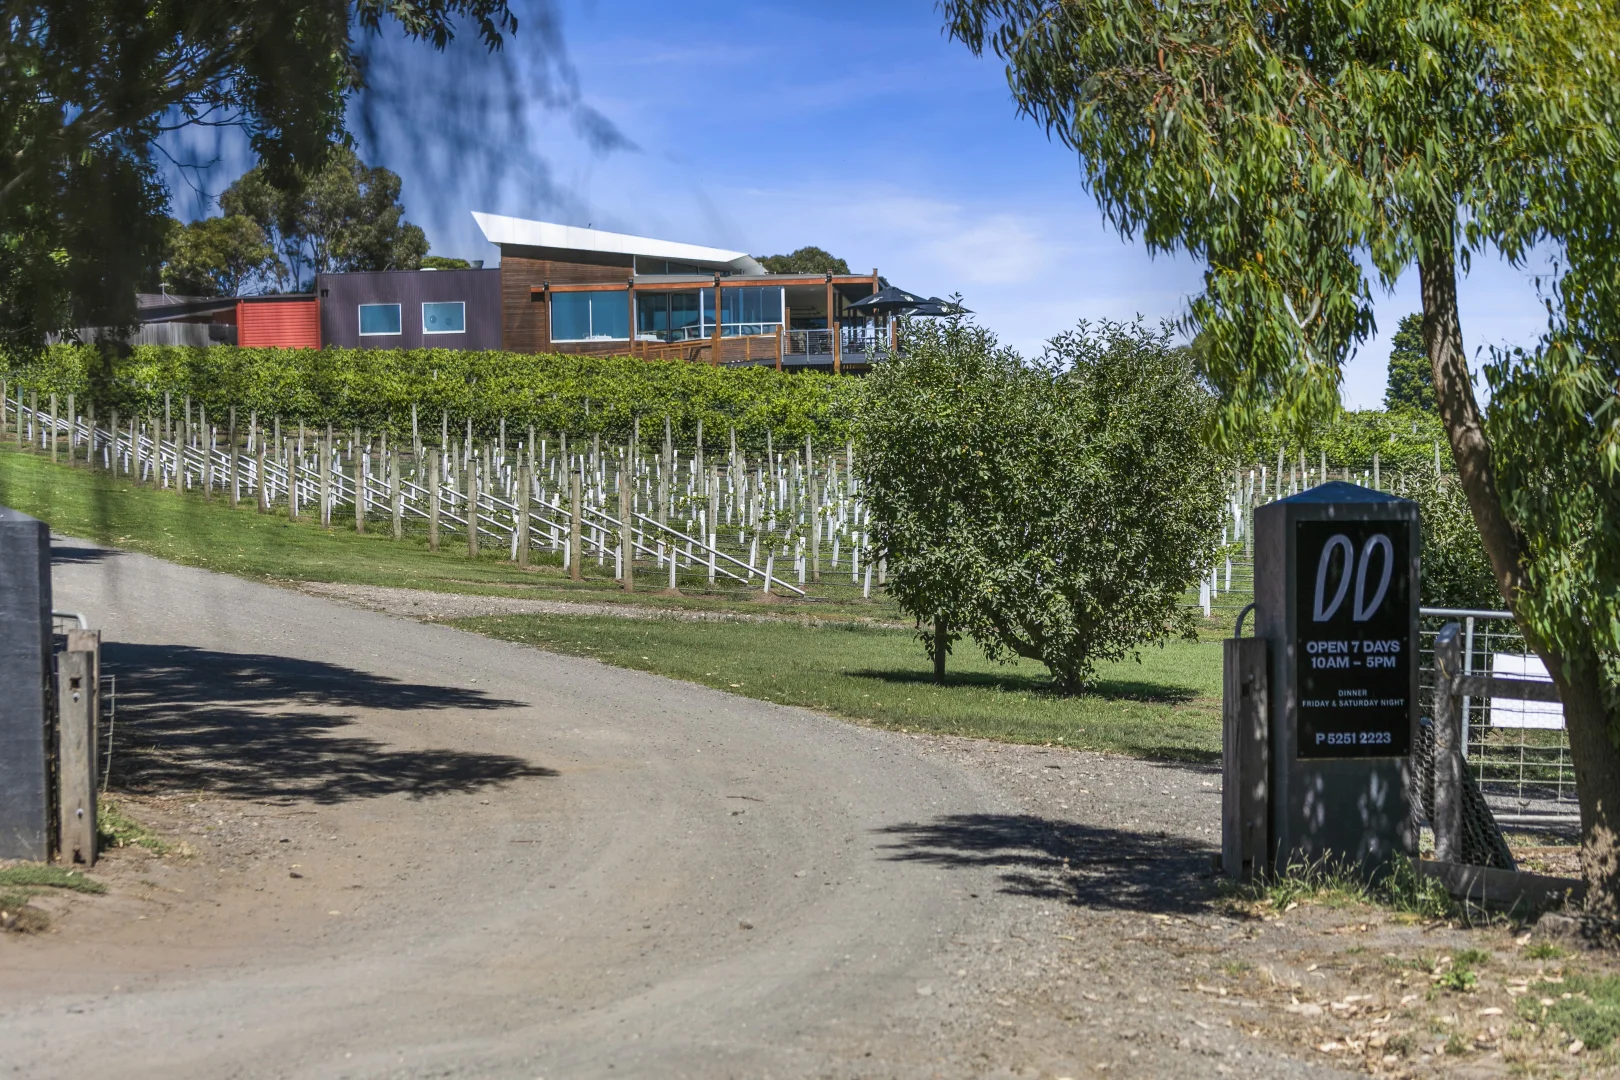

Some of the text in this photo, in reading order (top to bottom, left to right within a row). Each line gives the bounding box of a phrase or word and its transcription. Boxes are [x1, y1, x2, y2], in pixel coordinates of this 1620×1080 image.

[1306, 640, 1400, 653] OPEN 7 DAYS
[1311, 656, 1349, 669] 10AM
[1366, 656, 1396, 668] 5PM
[1338, 689, 1368, 697] DINNER
[1302, 700, 1330, 708] FRIDAY
[1338, 699, 1379, 707] SATURDAY
[1381, 699, 1405, 707] NIGHT
[1315, 732, 1392, 745] P 5251 2223
